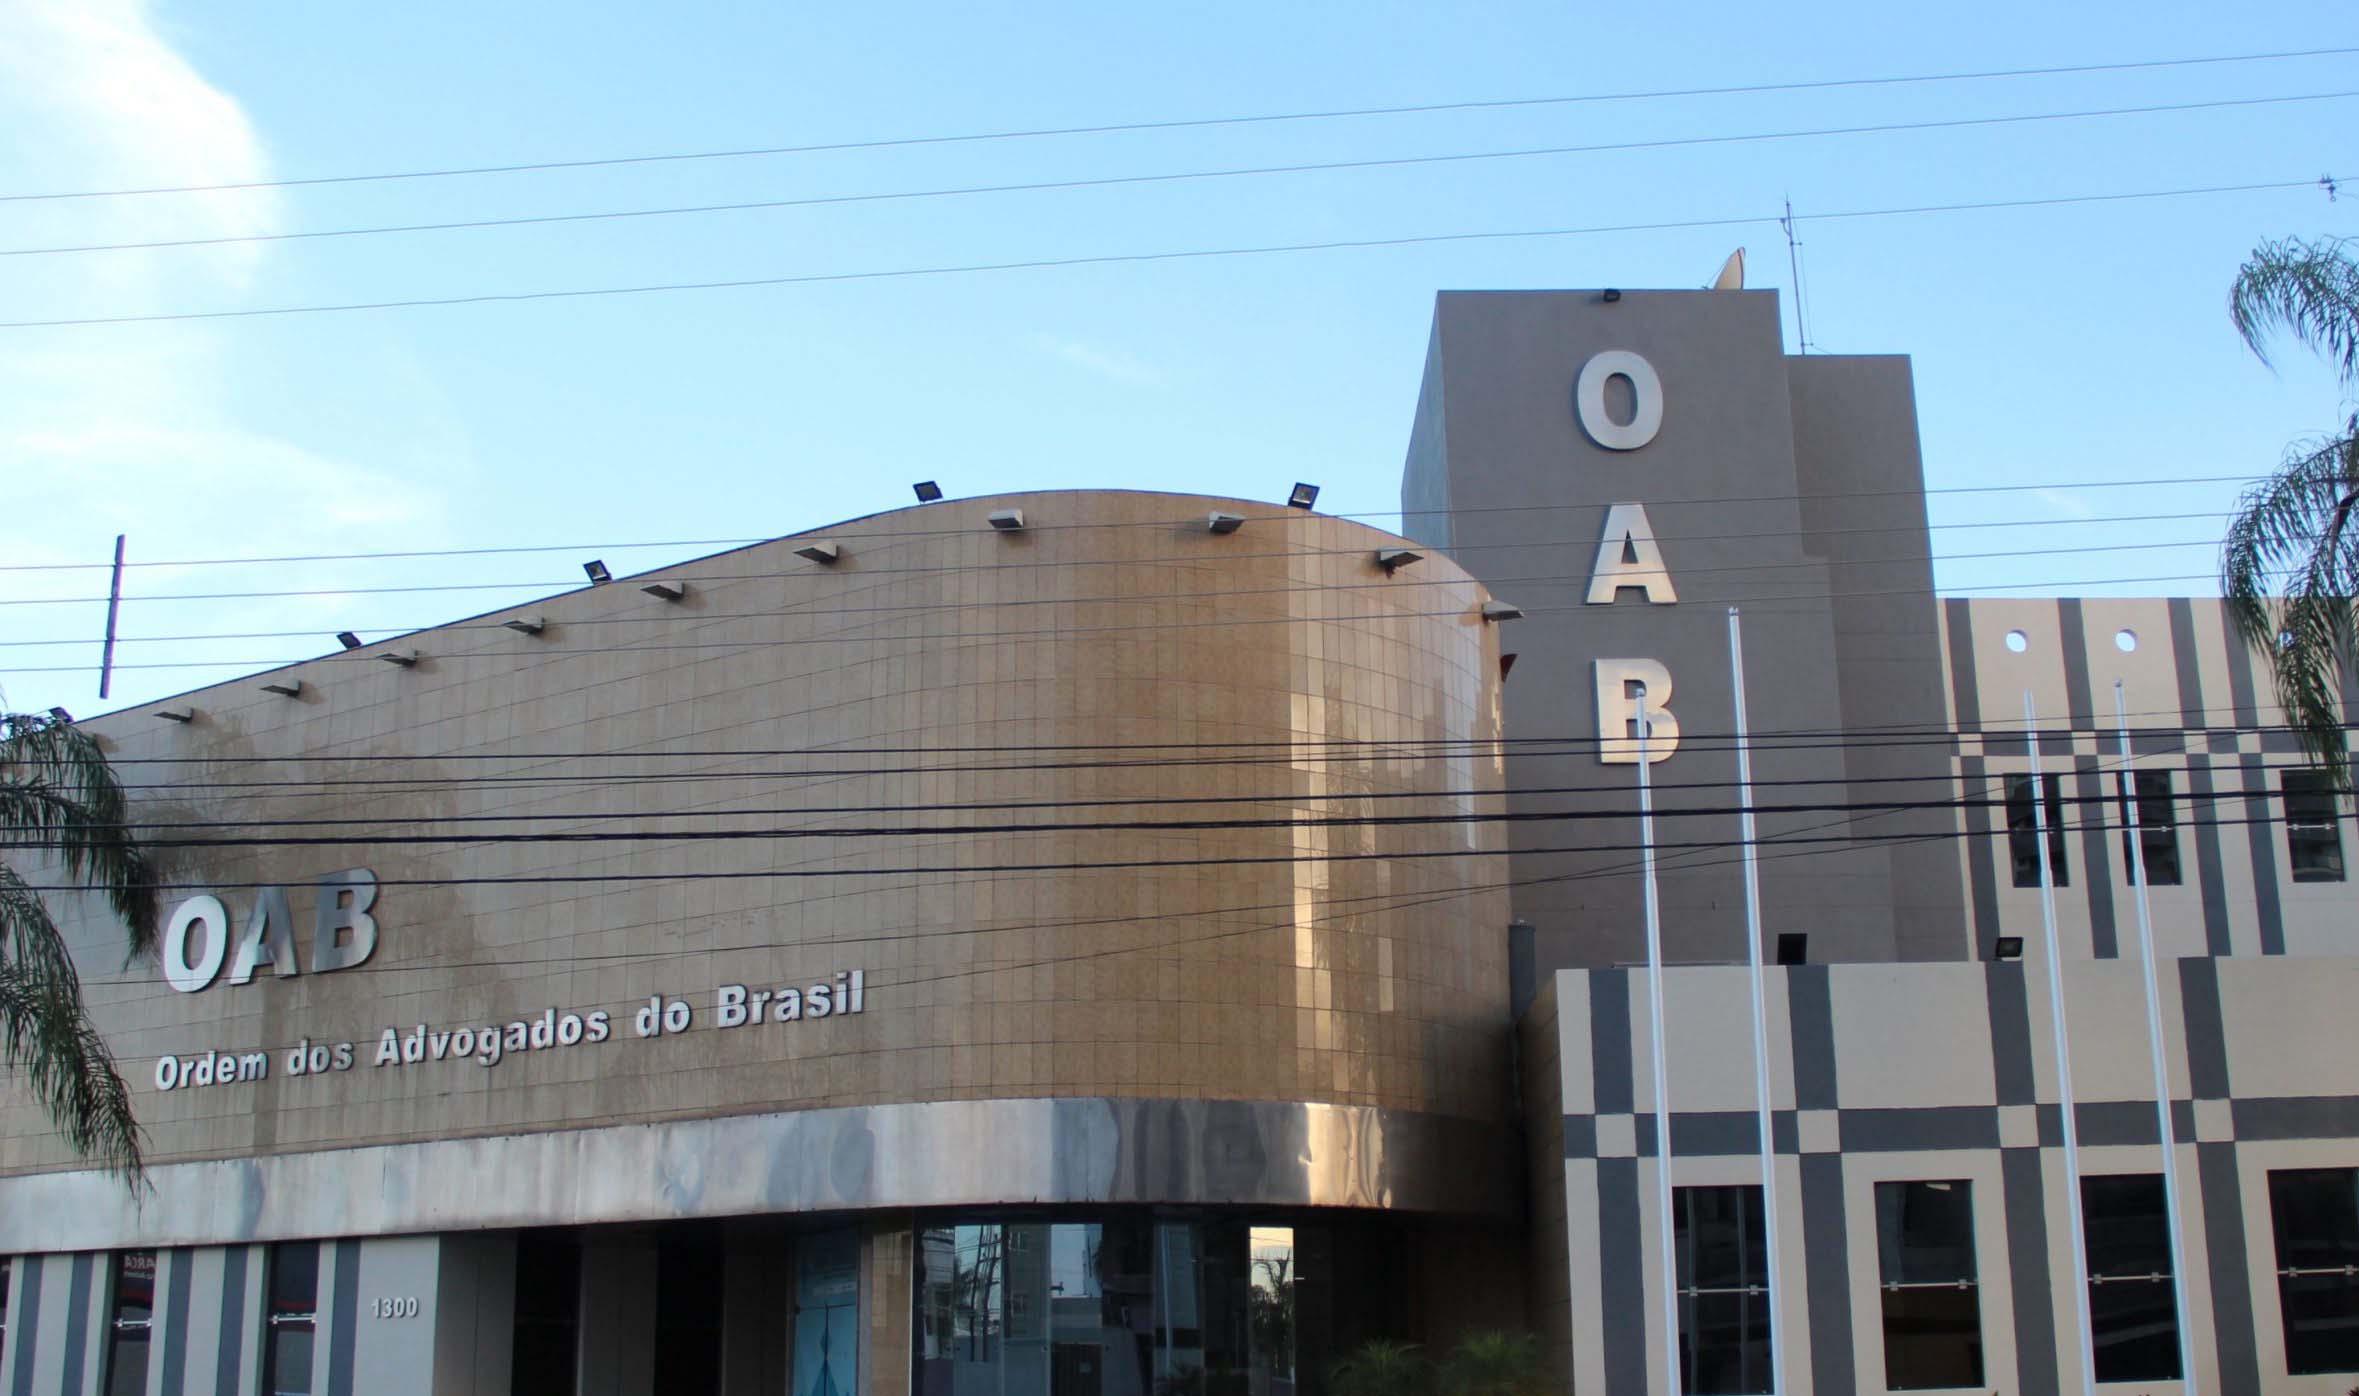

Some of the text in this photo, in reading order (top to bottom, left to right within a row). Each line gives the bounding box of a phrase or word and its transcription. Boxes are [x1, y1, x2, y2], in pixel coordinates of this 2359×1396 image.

[1576, 350, 1680, 764] OAB
[162, 867, 379, 993] OAB
[155, 969, 865, 1091] Ordem dos Advogados do Brasil
[371, 1297, 420, 1319] 1300
